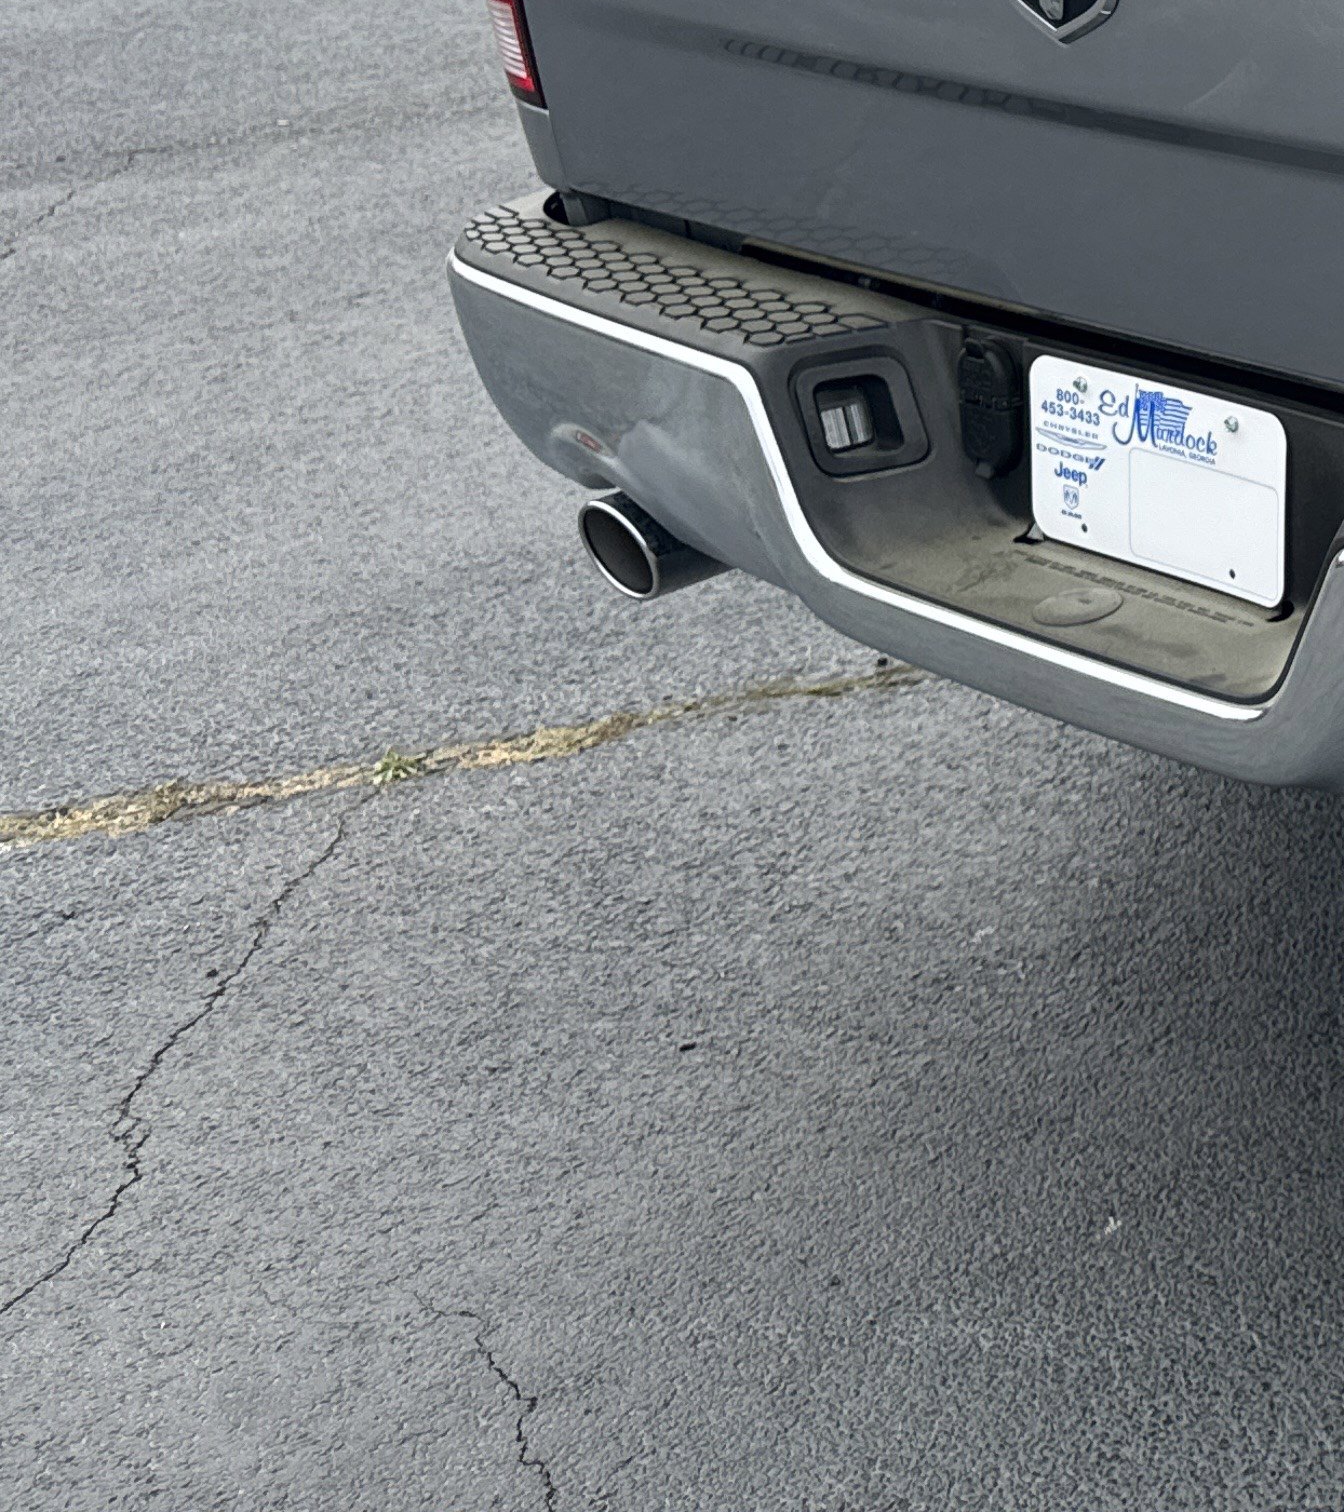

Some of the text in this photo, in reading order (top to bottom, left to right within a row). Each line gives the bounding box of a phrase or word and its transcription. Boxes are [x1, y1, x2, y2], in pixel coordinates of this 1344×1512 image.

[1056, 388, 1085, 405] 800-
[1041, 400, 1100, 426] 453-3433
[1098, 389, 1218, 456] Ed Murdock
[1054, 461, 1088, 487] Jeep
